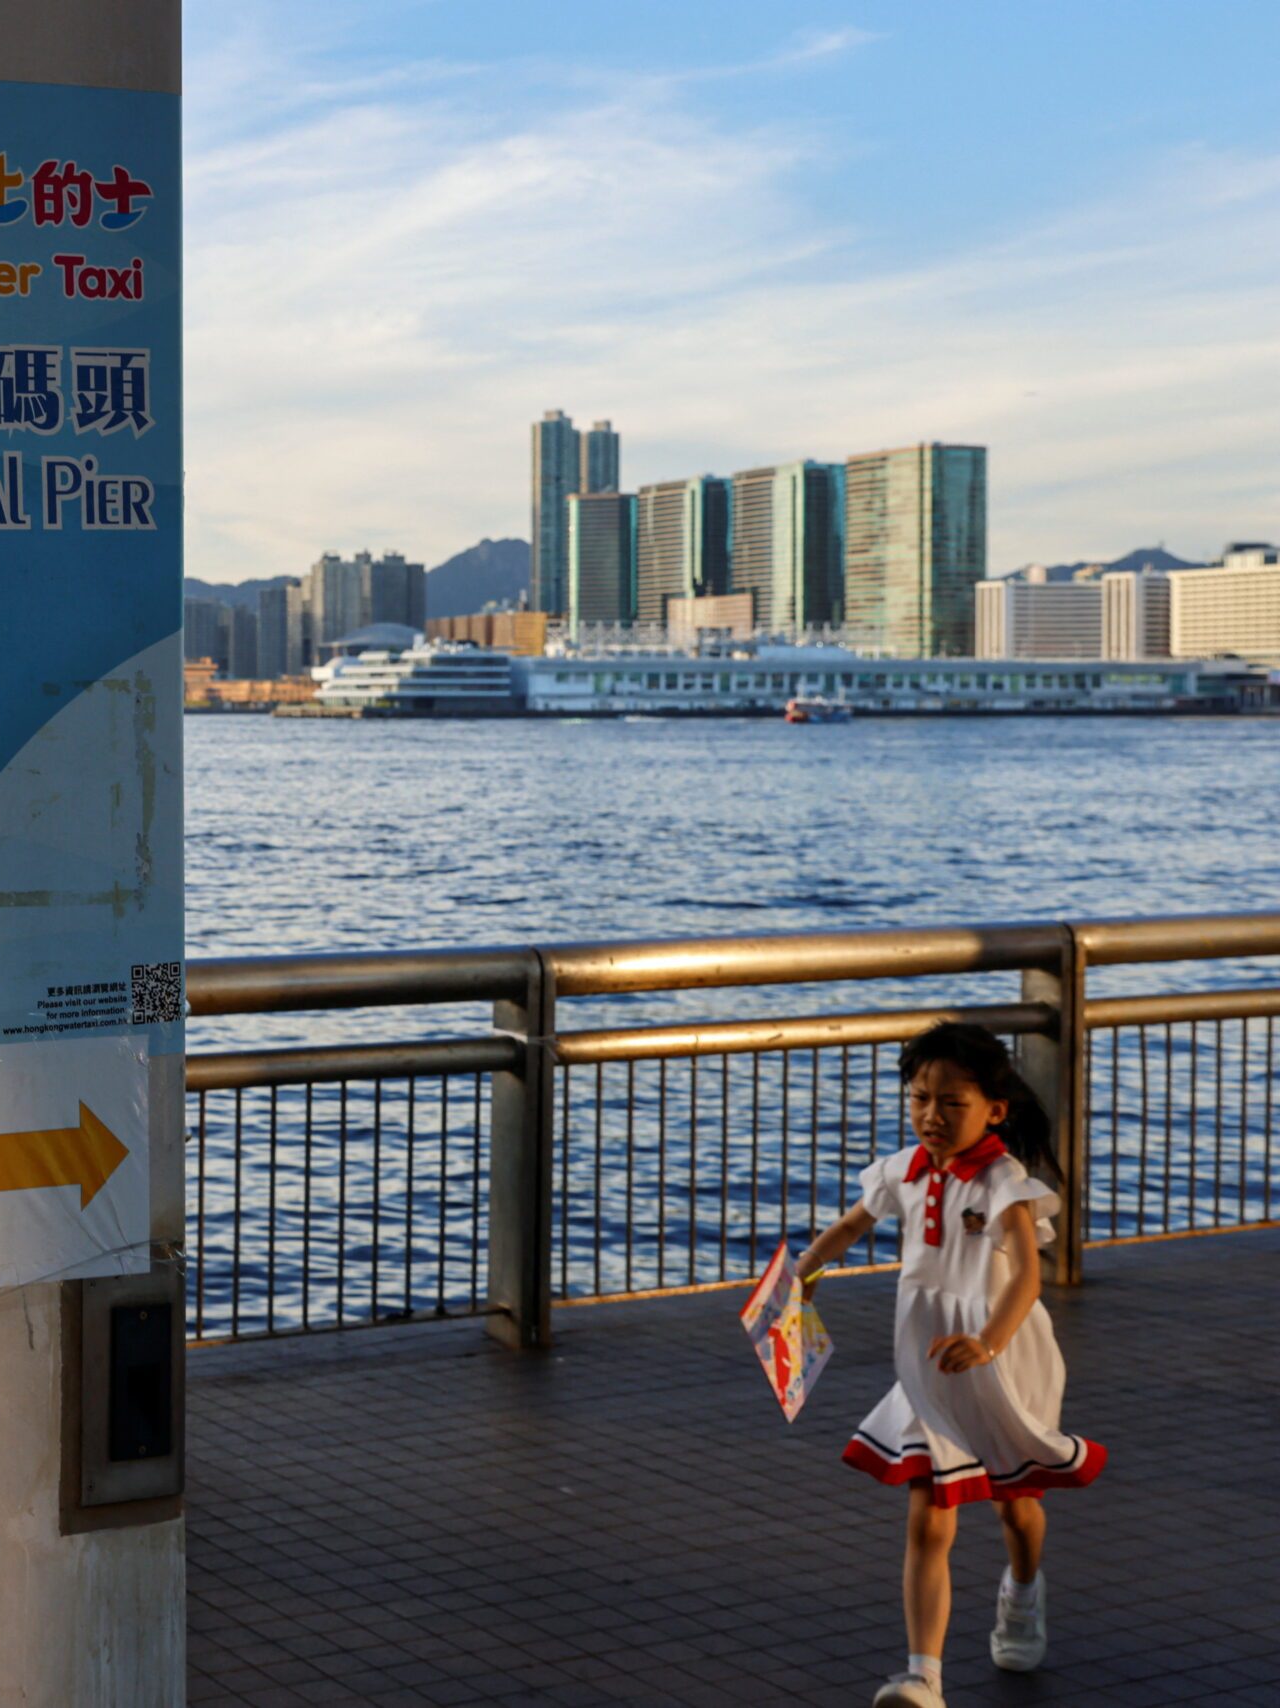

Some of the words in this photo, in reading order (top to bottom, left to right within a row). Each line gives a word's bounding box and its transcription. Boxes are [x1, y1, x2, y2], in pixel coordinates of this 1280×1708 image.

[53, 253, 144, 300] Taxi
[37, 1000, 63, 1009] Please
[65, 999, 81, 1007] visit
[97, 995, 127, 1004] website
[46, 1011, 57, 1020] for
